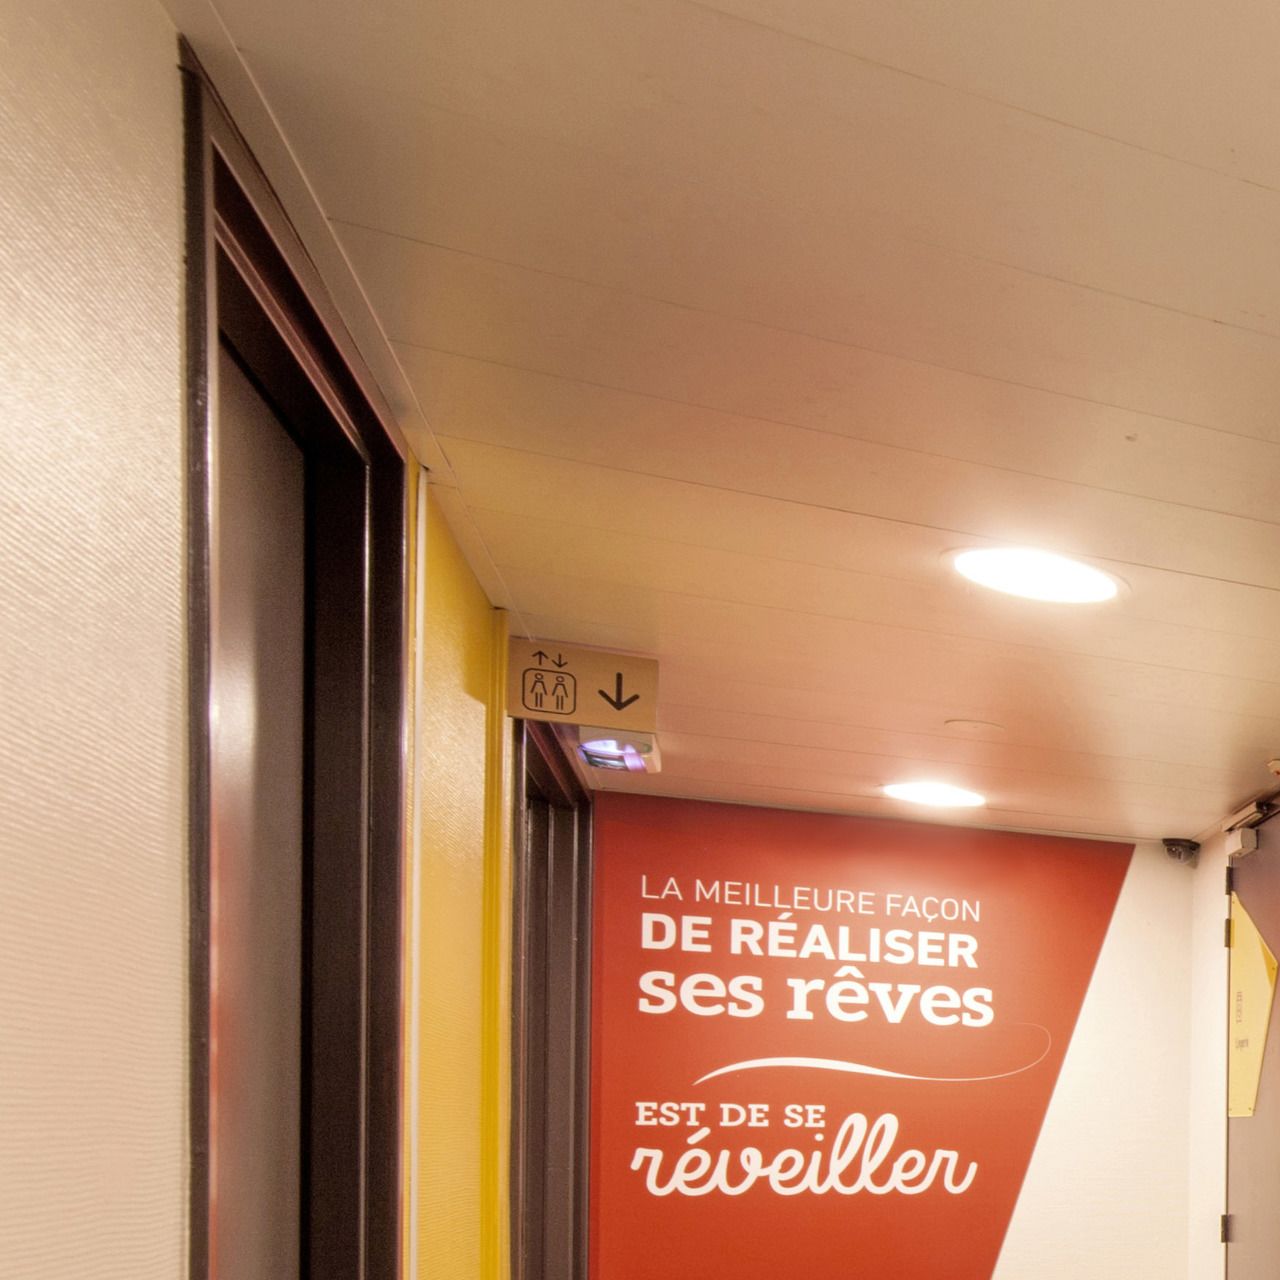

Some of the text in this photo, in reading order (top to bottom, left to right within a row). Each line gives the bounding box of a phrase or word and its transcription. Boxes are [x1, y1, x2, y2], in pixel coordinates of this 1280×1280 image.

[642, 875, 981, 923] LA MEILLEURE FAÇON
[641, 911, 979, 969] DE RÉALISER
[638, 965, 995, 1028] ses rêves
[635, 1101, 826, 1128] EST DE SE
[630, 1113, 978, 1197] réveiller
